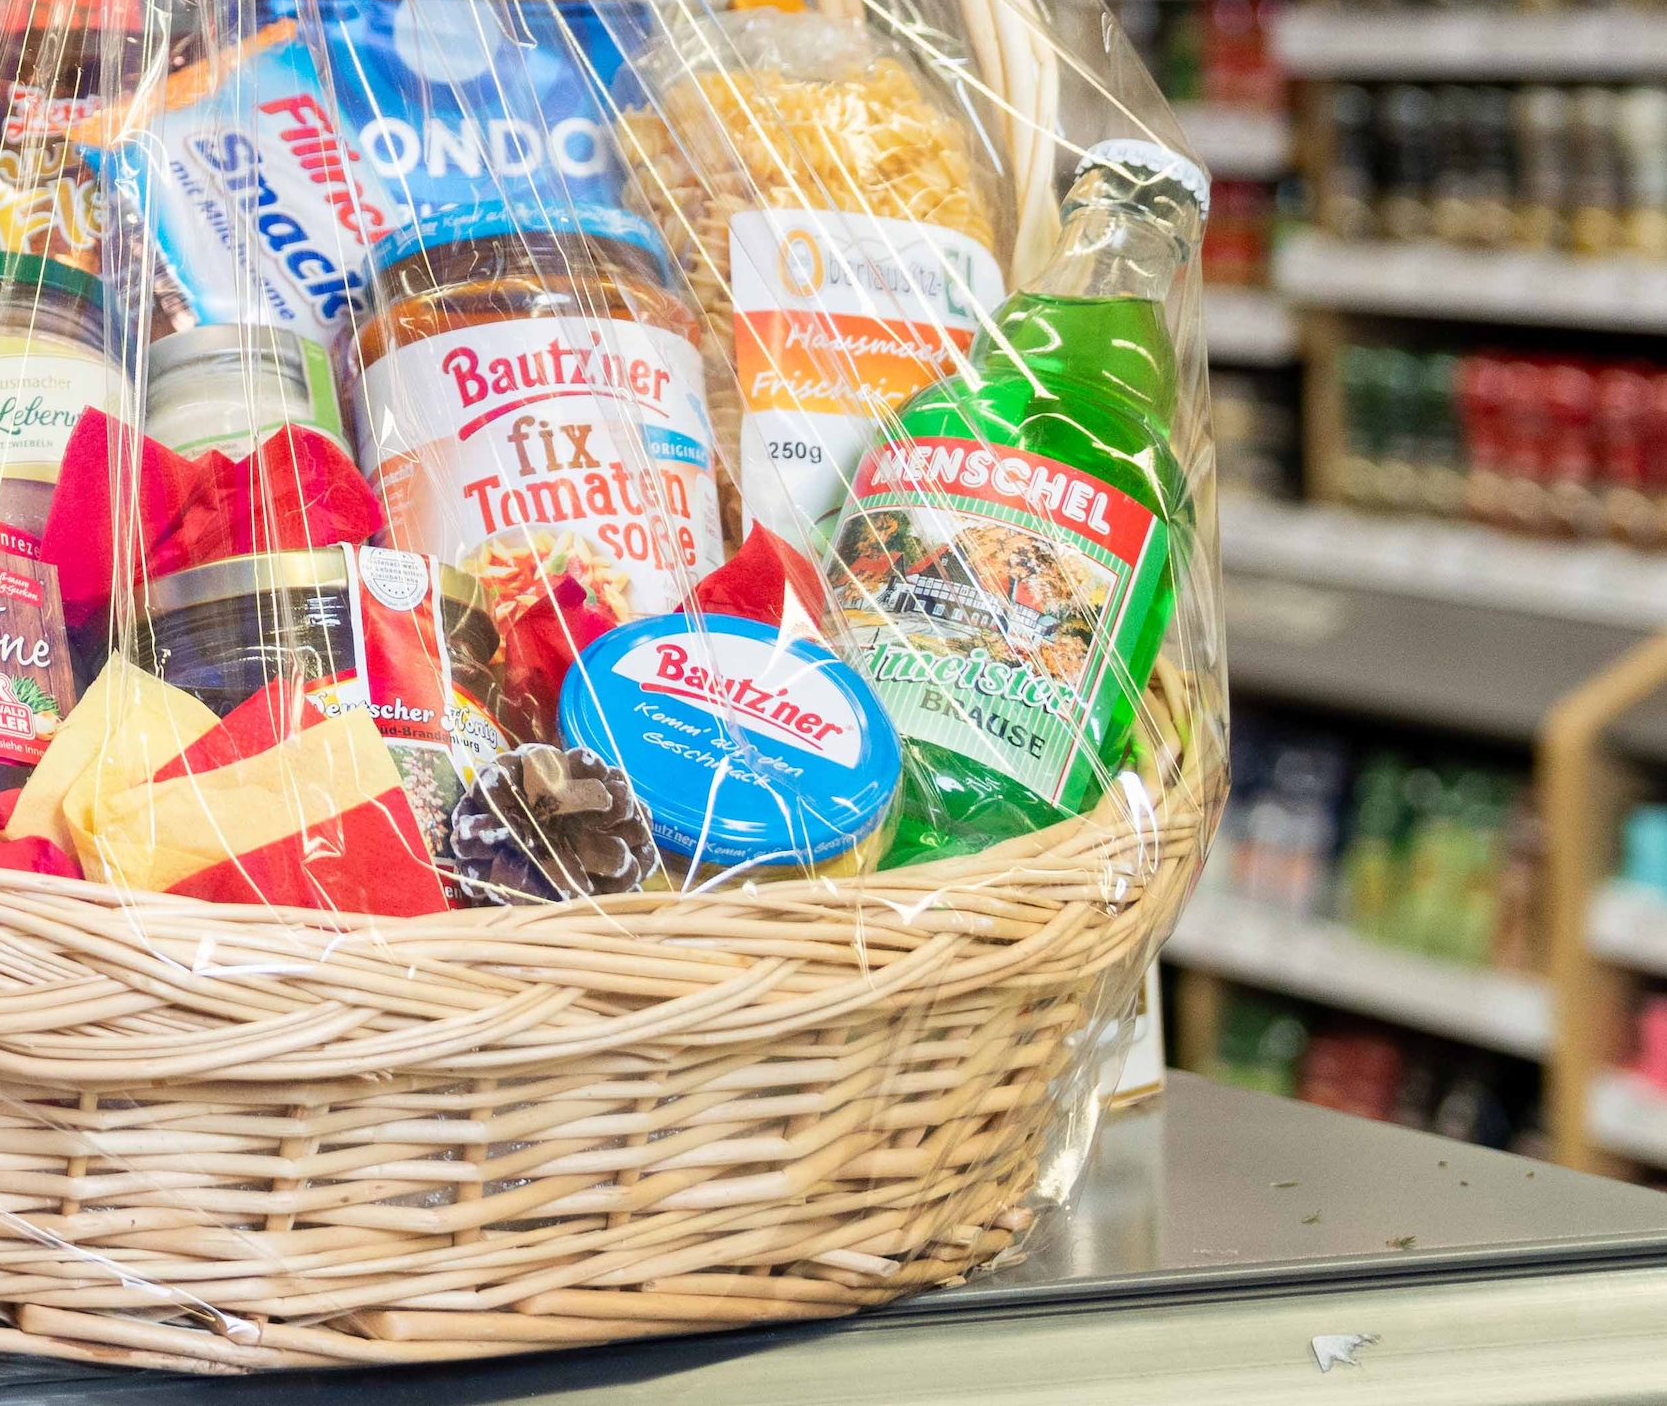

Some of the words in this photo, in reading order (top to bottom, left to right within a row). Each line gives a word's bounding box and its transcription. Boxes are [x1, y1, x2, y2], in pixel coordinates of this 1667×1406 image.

[359, 116, 605, 180] ONDO
[224, 132, 365, 320] Snack
[442, 329, 670, 408] Bautz'ner
[506, 415, 600, 478] fix
[768, 441, 822, 464] 250g
[463, 462, 692, 536] Tomaten
[871, 444, 1111, 535] MENSCHEL
[655, 643, 844, 743] Bautz'ner
[919, 689, 1046, 761] BRAUSE
[633, 700, 713, 738] Komm'
[764, 753, 806, 778] den
